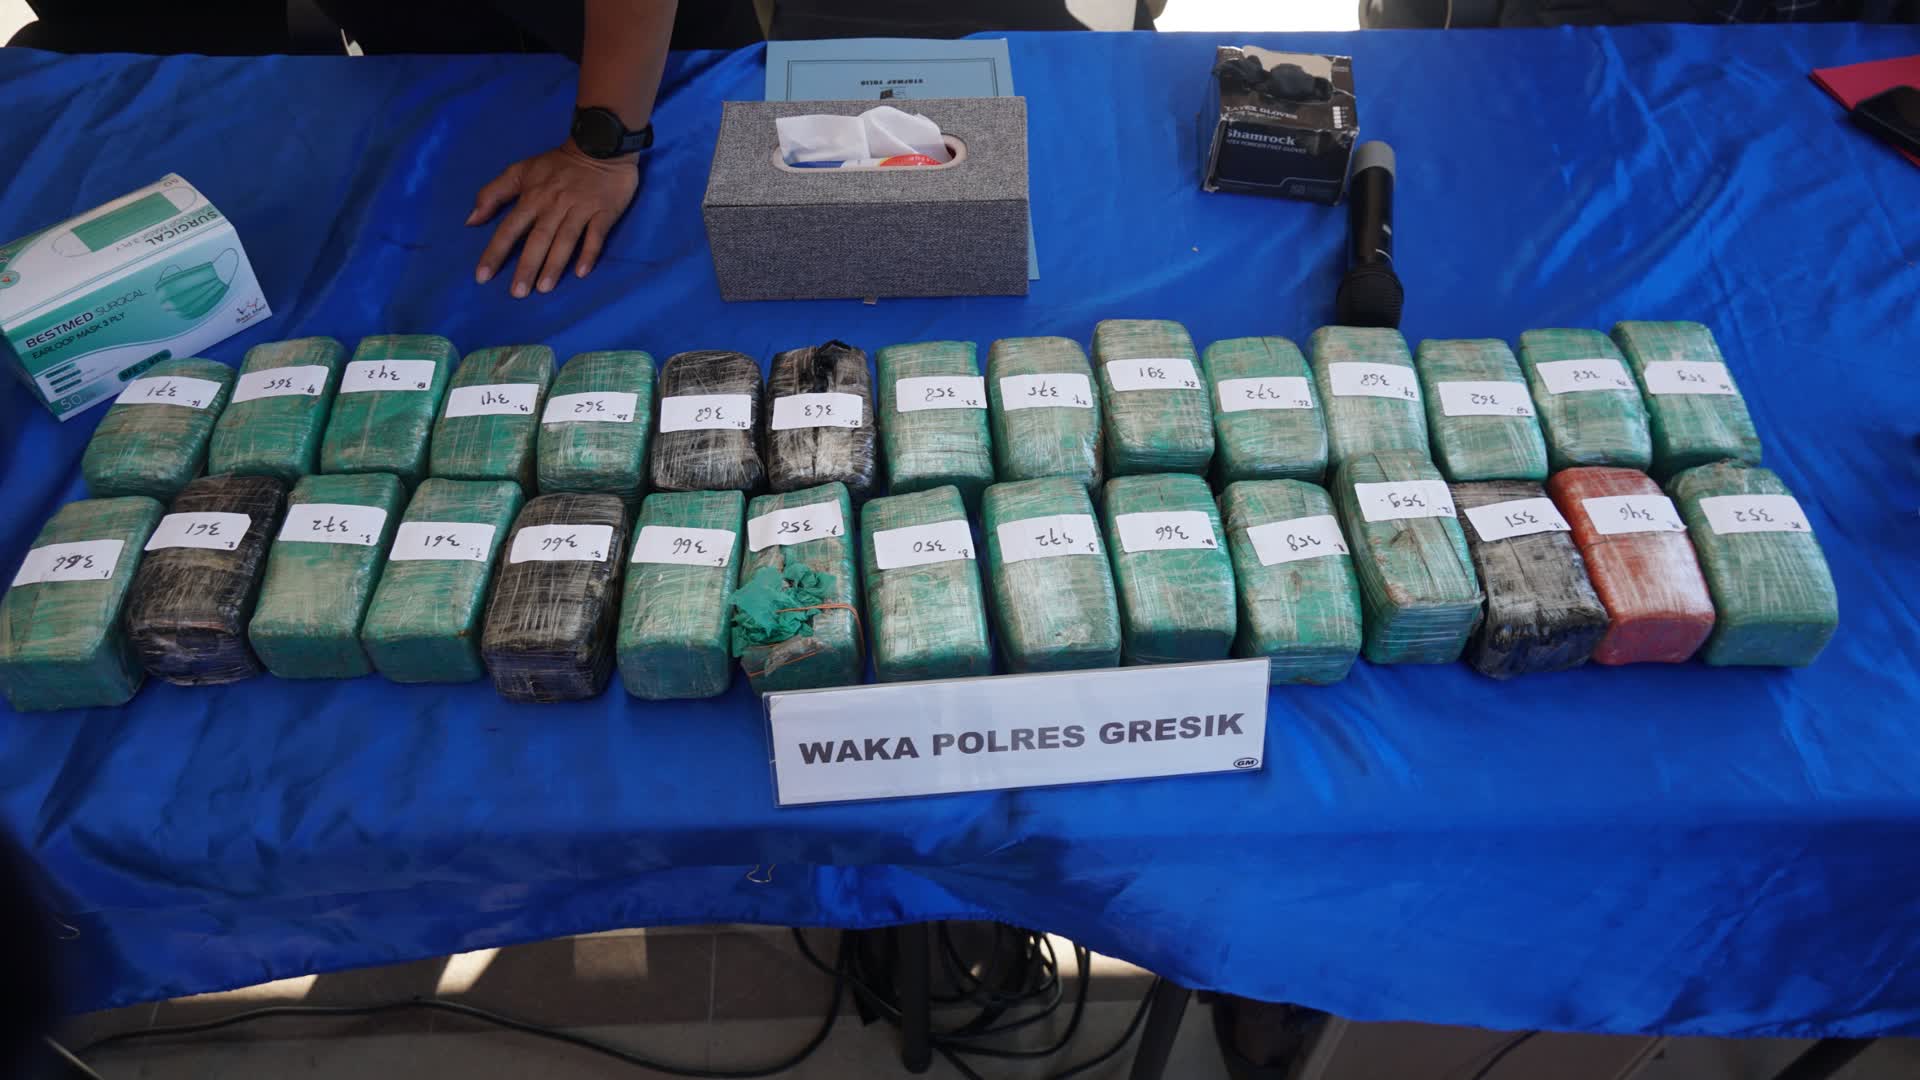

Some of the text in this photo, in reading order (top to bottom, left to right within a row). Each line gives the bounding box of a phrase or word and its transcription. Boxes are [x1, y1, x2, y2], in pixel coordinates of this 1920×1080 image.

[145, 211, 218, 245] SURGICAL
[26, 289, 145, 348] BESTMED SURGICAL
[32, 336, 75, 360] EARLOOP
[76, 324, 102, 340] MASK
[1137, 366, 1167, 380] 391
[1359, 373, 1391, 387] 368
[146, 380, 177, 398] 371
[924, 386, 957, 403] 358
[1027, 381, 1058, 398] 375
[1245, 383, 1281, 400] 372
[480, 391, 510, 406] 341
[574, 400, 606, 414] 362
[1470, 392, 1500, 406] 362
[803, 403, 834, 417] 363
[1503, 510, 1539, 527] 351
[1618, 502, 1654, 520] 346
[1733, 507, 1774, 523] 352
[184, 521, 222, 536] 361
[311, 515, 349, 534] 372
[1154, 524, 1190, 541] 366
[424, 533, 461, 548] 361
[541, 533, 578, 552] 366
[672, 536, 708, 555] 366
[1034, 527, 1075, 548] 372
[1285, 534, 1322, 552] 358
[912, 539, 947, 554] 350
[799, 713, 1245, 765] WAKA POLRES GRESIK
[1237, 759, 1255, 767] GM
